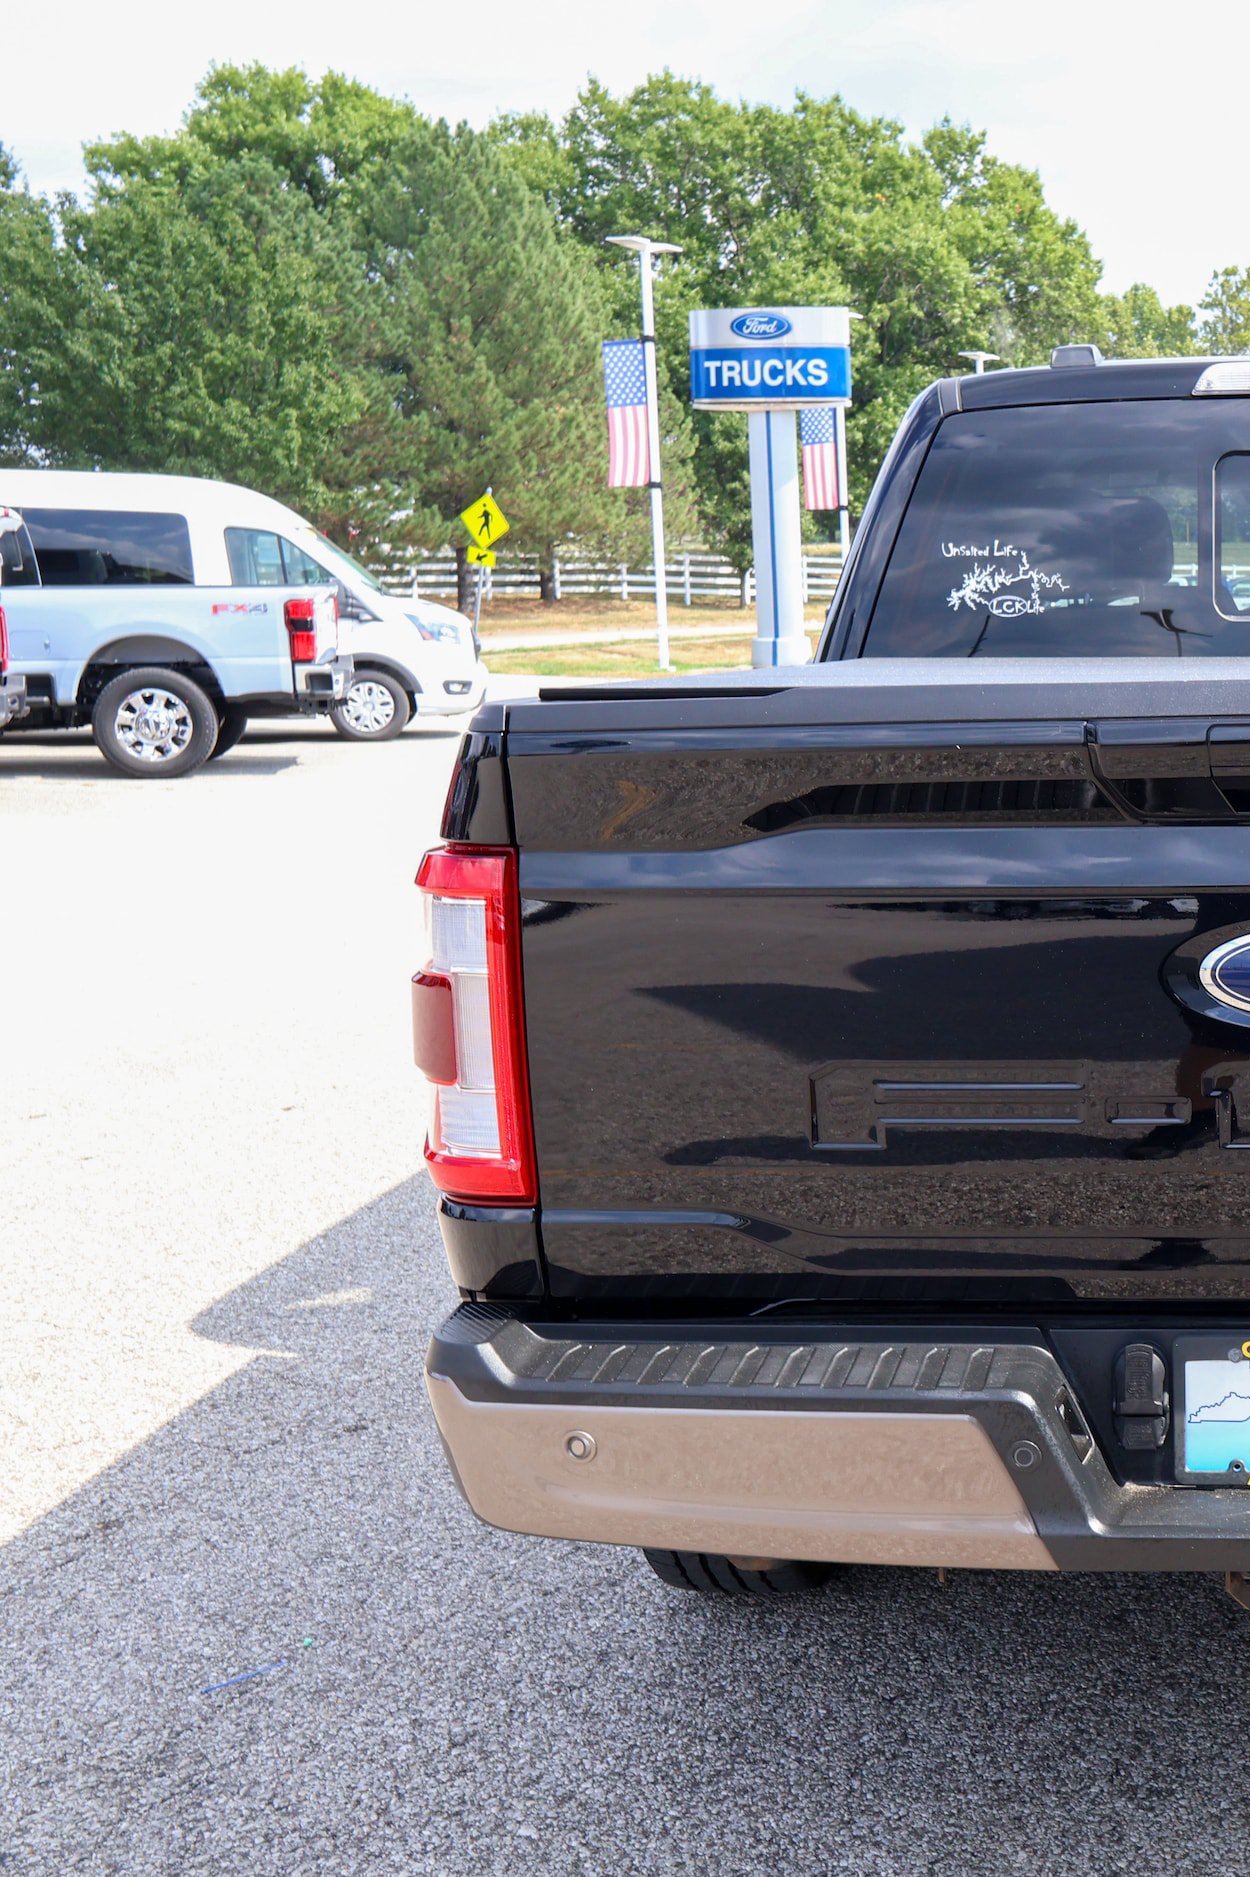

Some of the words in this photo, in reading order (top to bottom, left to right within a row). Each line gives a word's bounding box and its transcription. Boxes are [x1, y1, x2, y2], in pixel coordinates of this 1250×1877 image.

[743, 316, 777, 334] Ford
[704, 359, 829, 387] TRUCKS
[993, 600, 1026, 614] LCK
